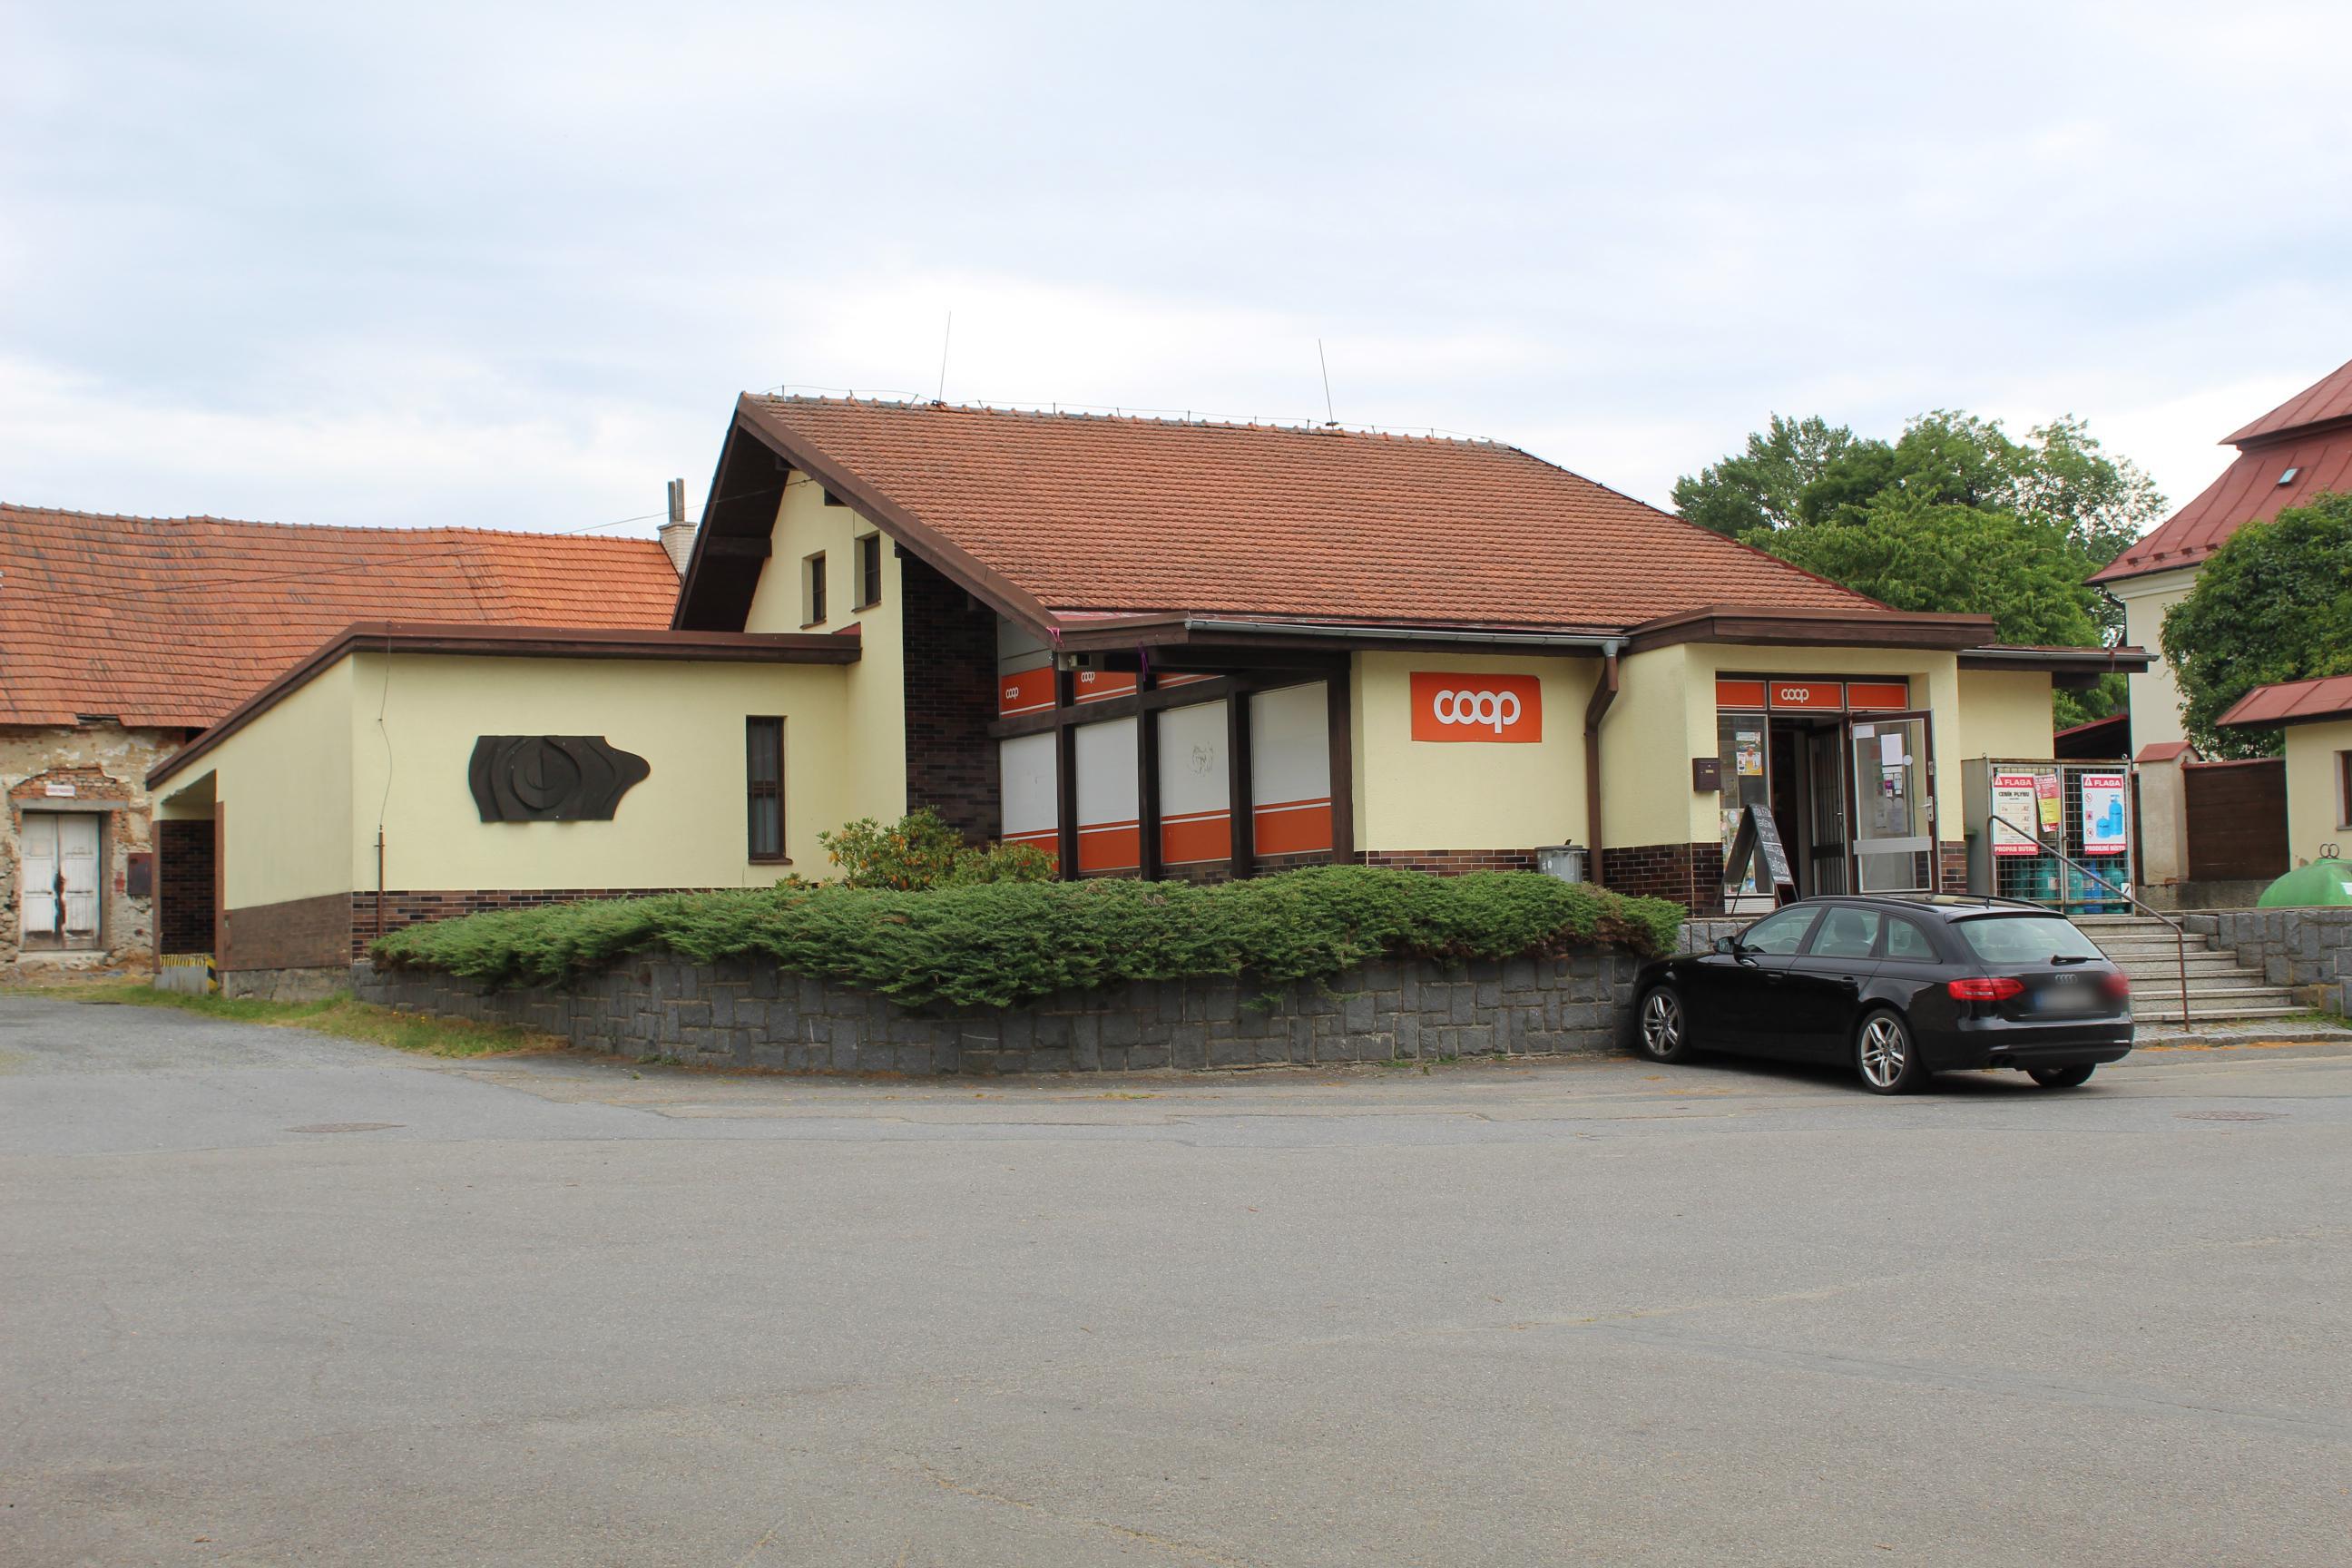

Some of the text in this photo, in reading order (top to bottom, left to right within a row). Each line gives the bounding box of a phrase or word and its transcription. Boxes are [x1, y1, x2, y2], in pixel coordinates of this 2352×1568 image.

[1081, 671, 1095, 683] coop
[1005, 686, 1019, 700] coop
[1781, 688, 1809, 703] coop
[1434, 690, 1521, 734] coop
[2004, 779, 2033, 787] FLAGA
